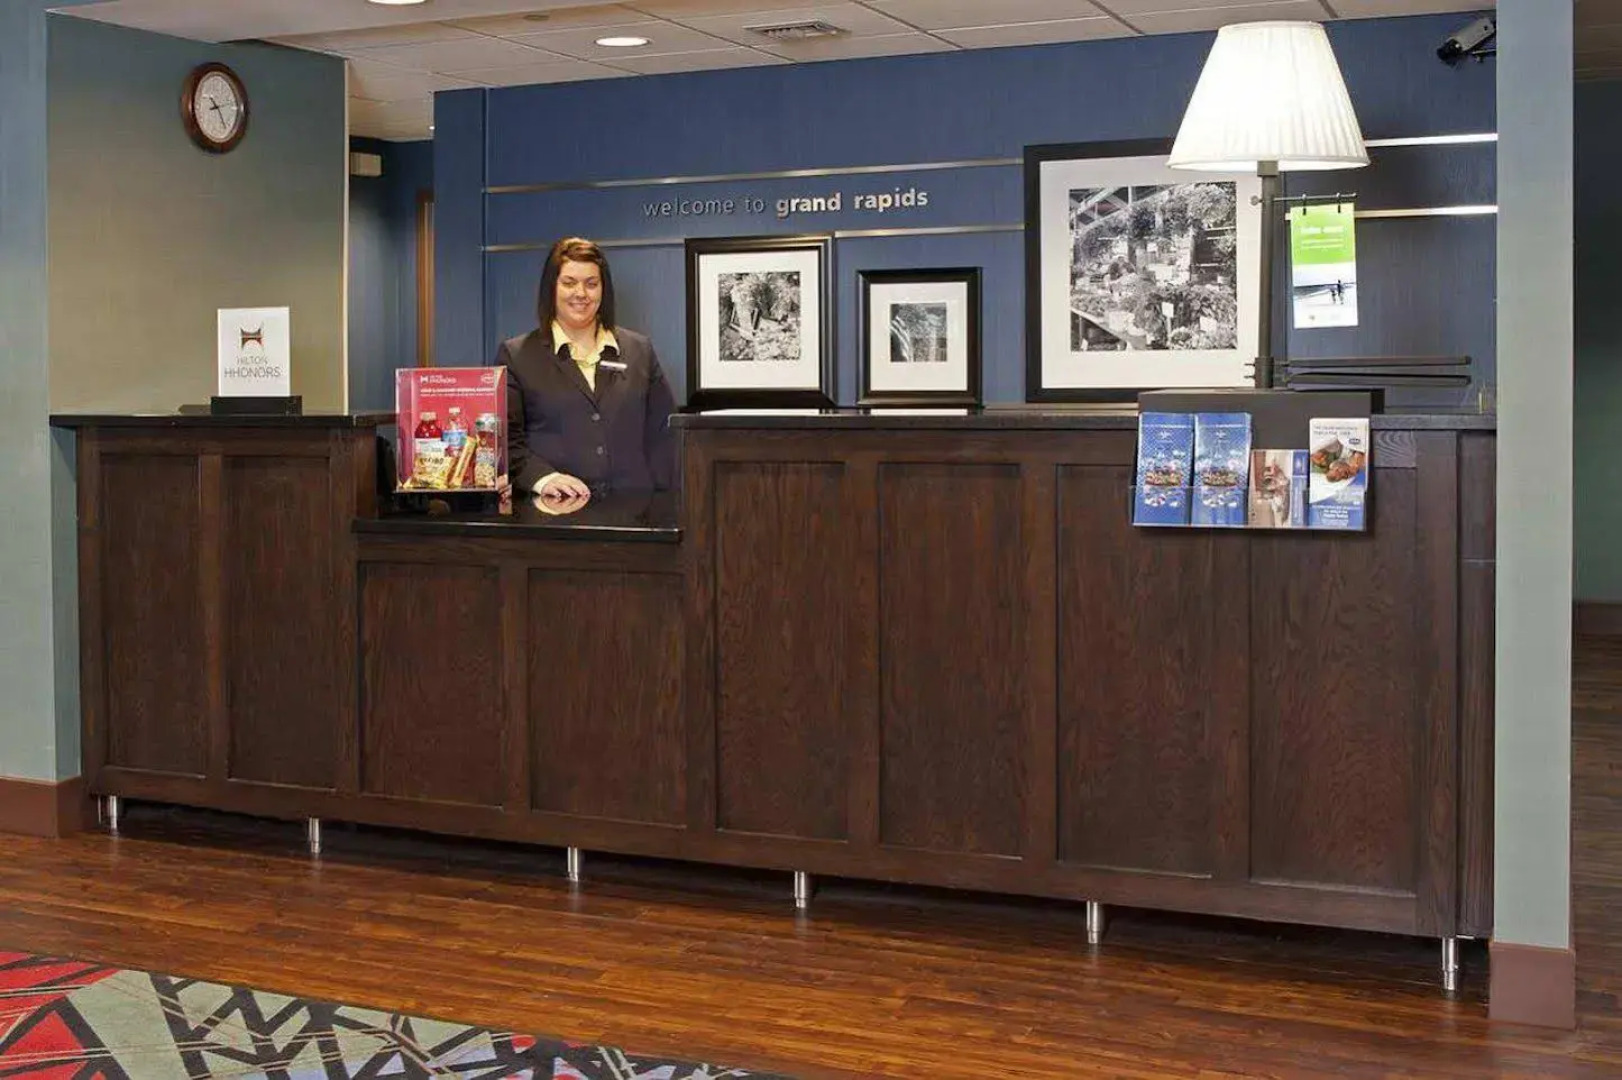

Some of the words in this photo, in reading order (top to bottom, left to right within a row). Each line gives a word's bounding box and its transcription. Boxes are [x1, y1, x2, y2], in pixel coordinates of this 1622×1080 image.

[642, 195, 734, 218] welcome
[744, 195, 766, 213] to
[776, 192, 842, 219] grand
[854, 187, 929, 212] rapids
[236, 355, 268, 366] HILTON
[224, 366, 282, 378] HHONORS
